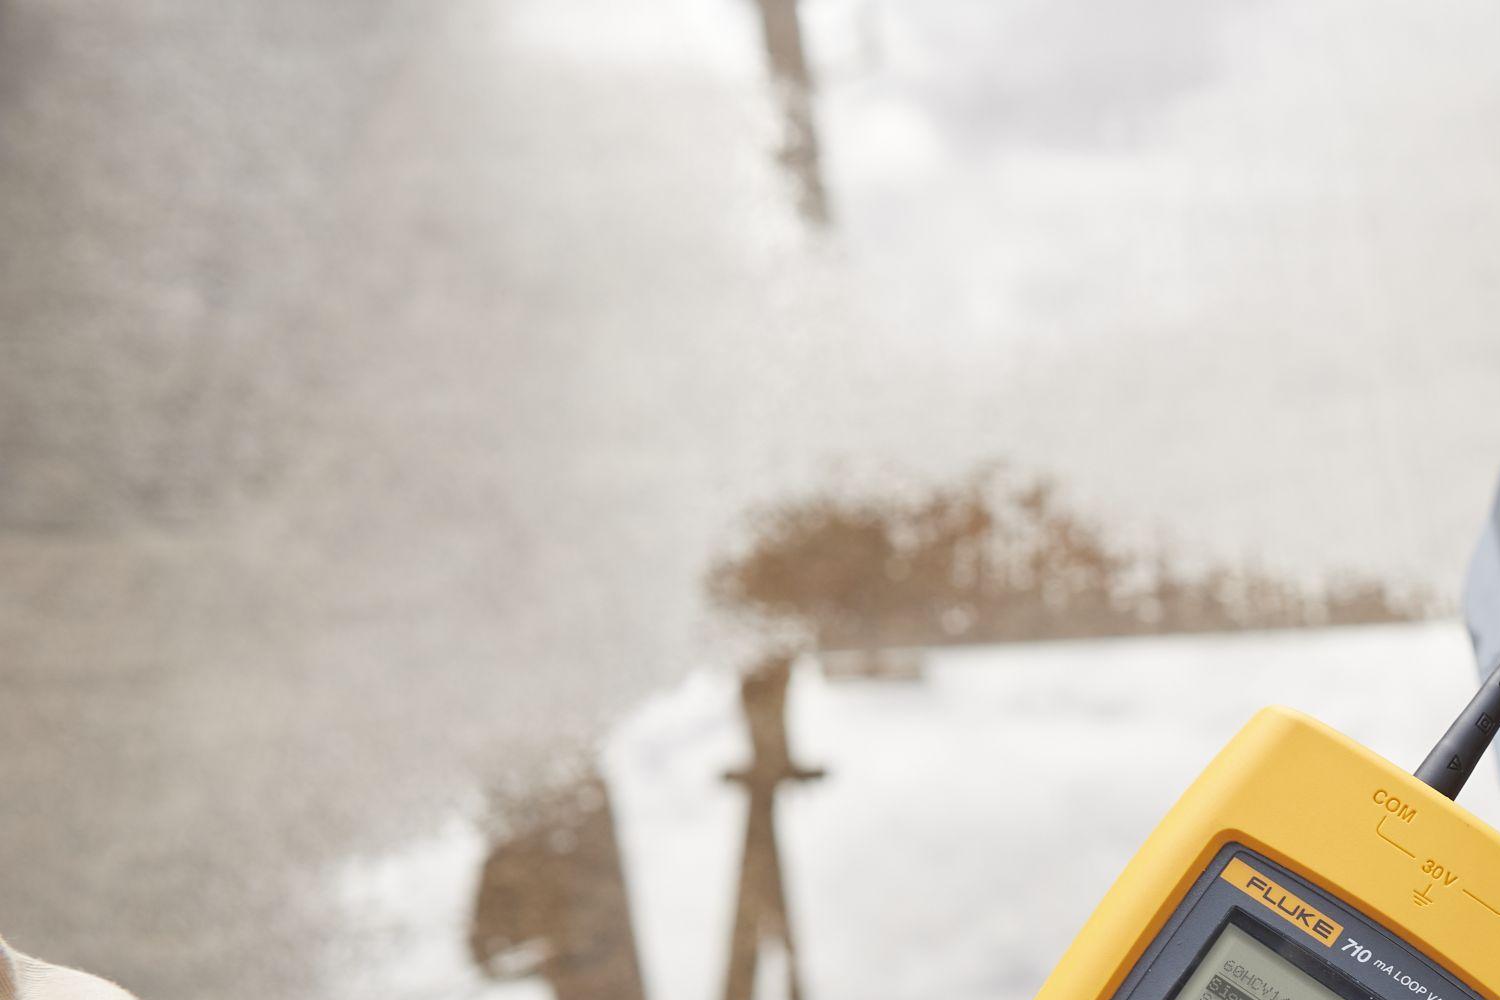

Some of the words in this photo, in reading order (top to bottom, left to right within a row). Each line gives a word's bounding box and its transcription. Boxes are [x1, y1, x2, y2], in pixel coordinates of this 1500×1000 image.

[1372, 789, 1417, 823] COM
[1421, 859, 1458, 887] 30V
[1246, 876, 1335, 940] FLUKE
[1340, 938, 1373, 963] 710
[1373, 959, 1395, 976] mA
[1393, 971, 1428, 995] LOOP
